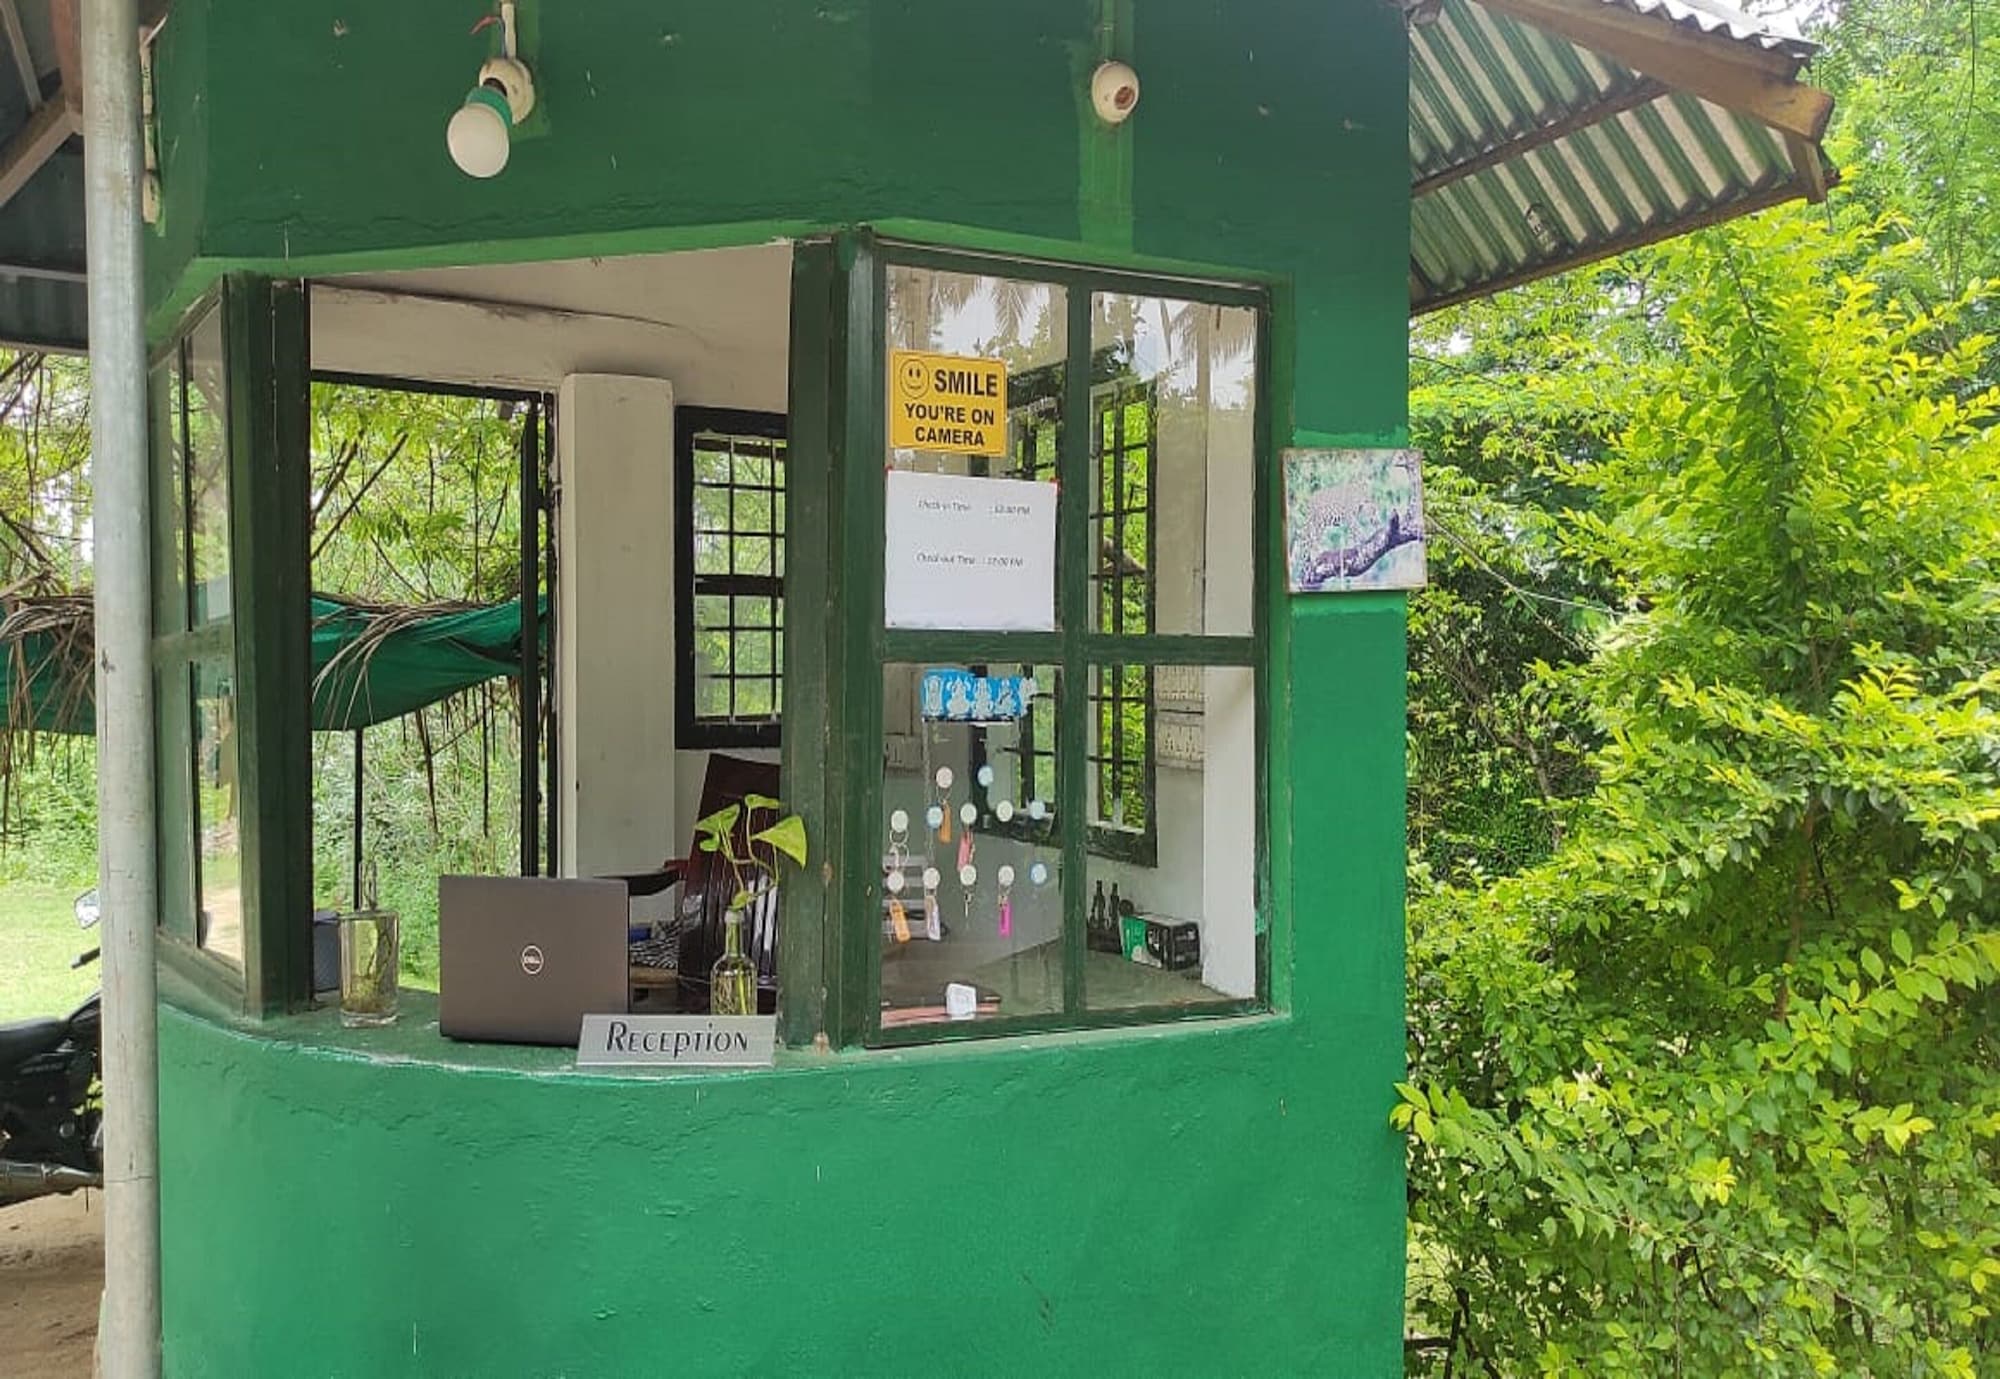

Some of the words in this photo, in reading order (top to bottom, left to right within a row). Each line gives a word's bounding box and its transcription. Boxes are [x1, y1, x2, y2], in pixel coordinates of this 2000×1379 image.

[934, 369, 998, 397] SMILE
[904, 403, 966, 424] YOU'RE
[971, 409, 995, 425] ON
[915, 426, 985, 446] CAMERA
[957, 554, 976, 565] Time
